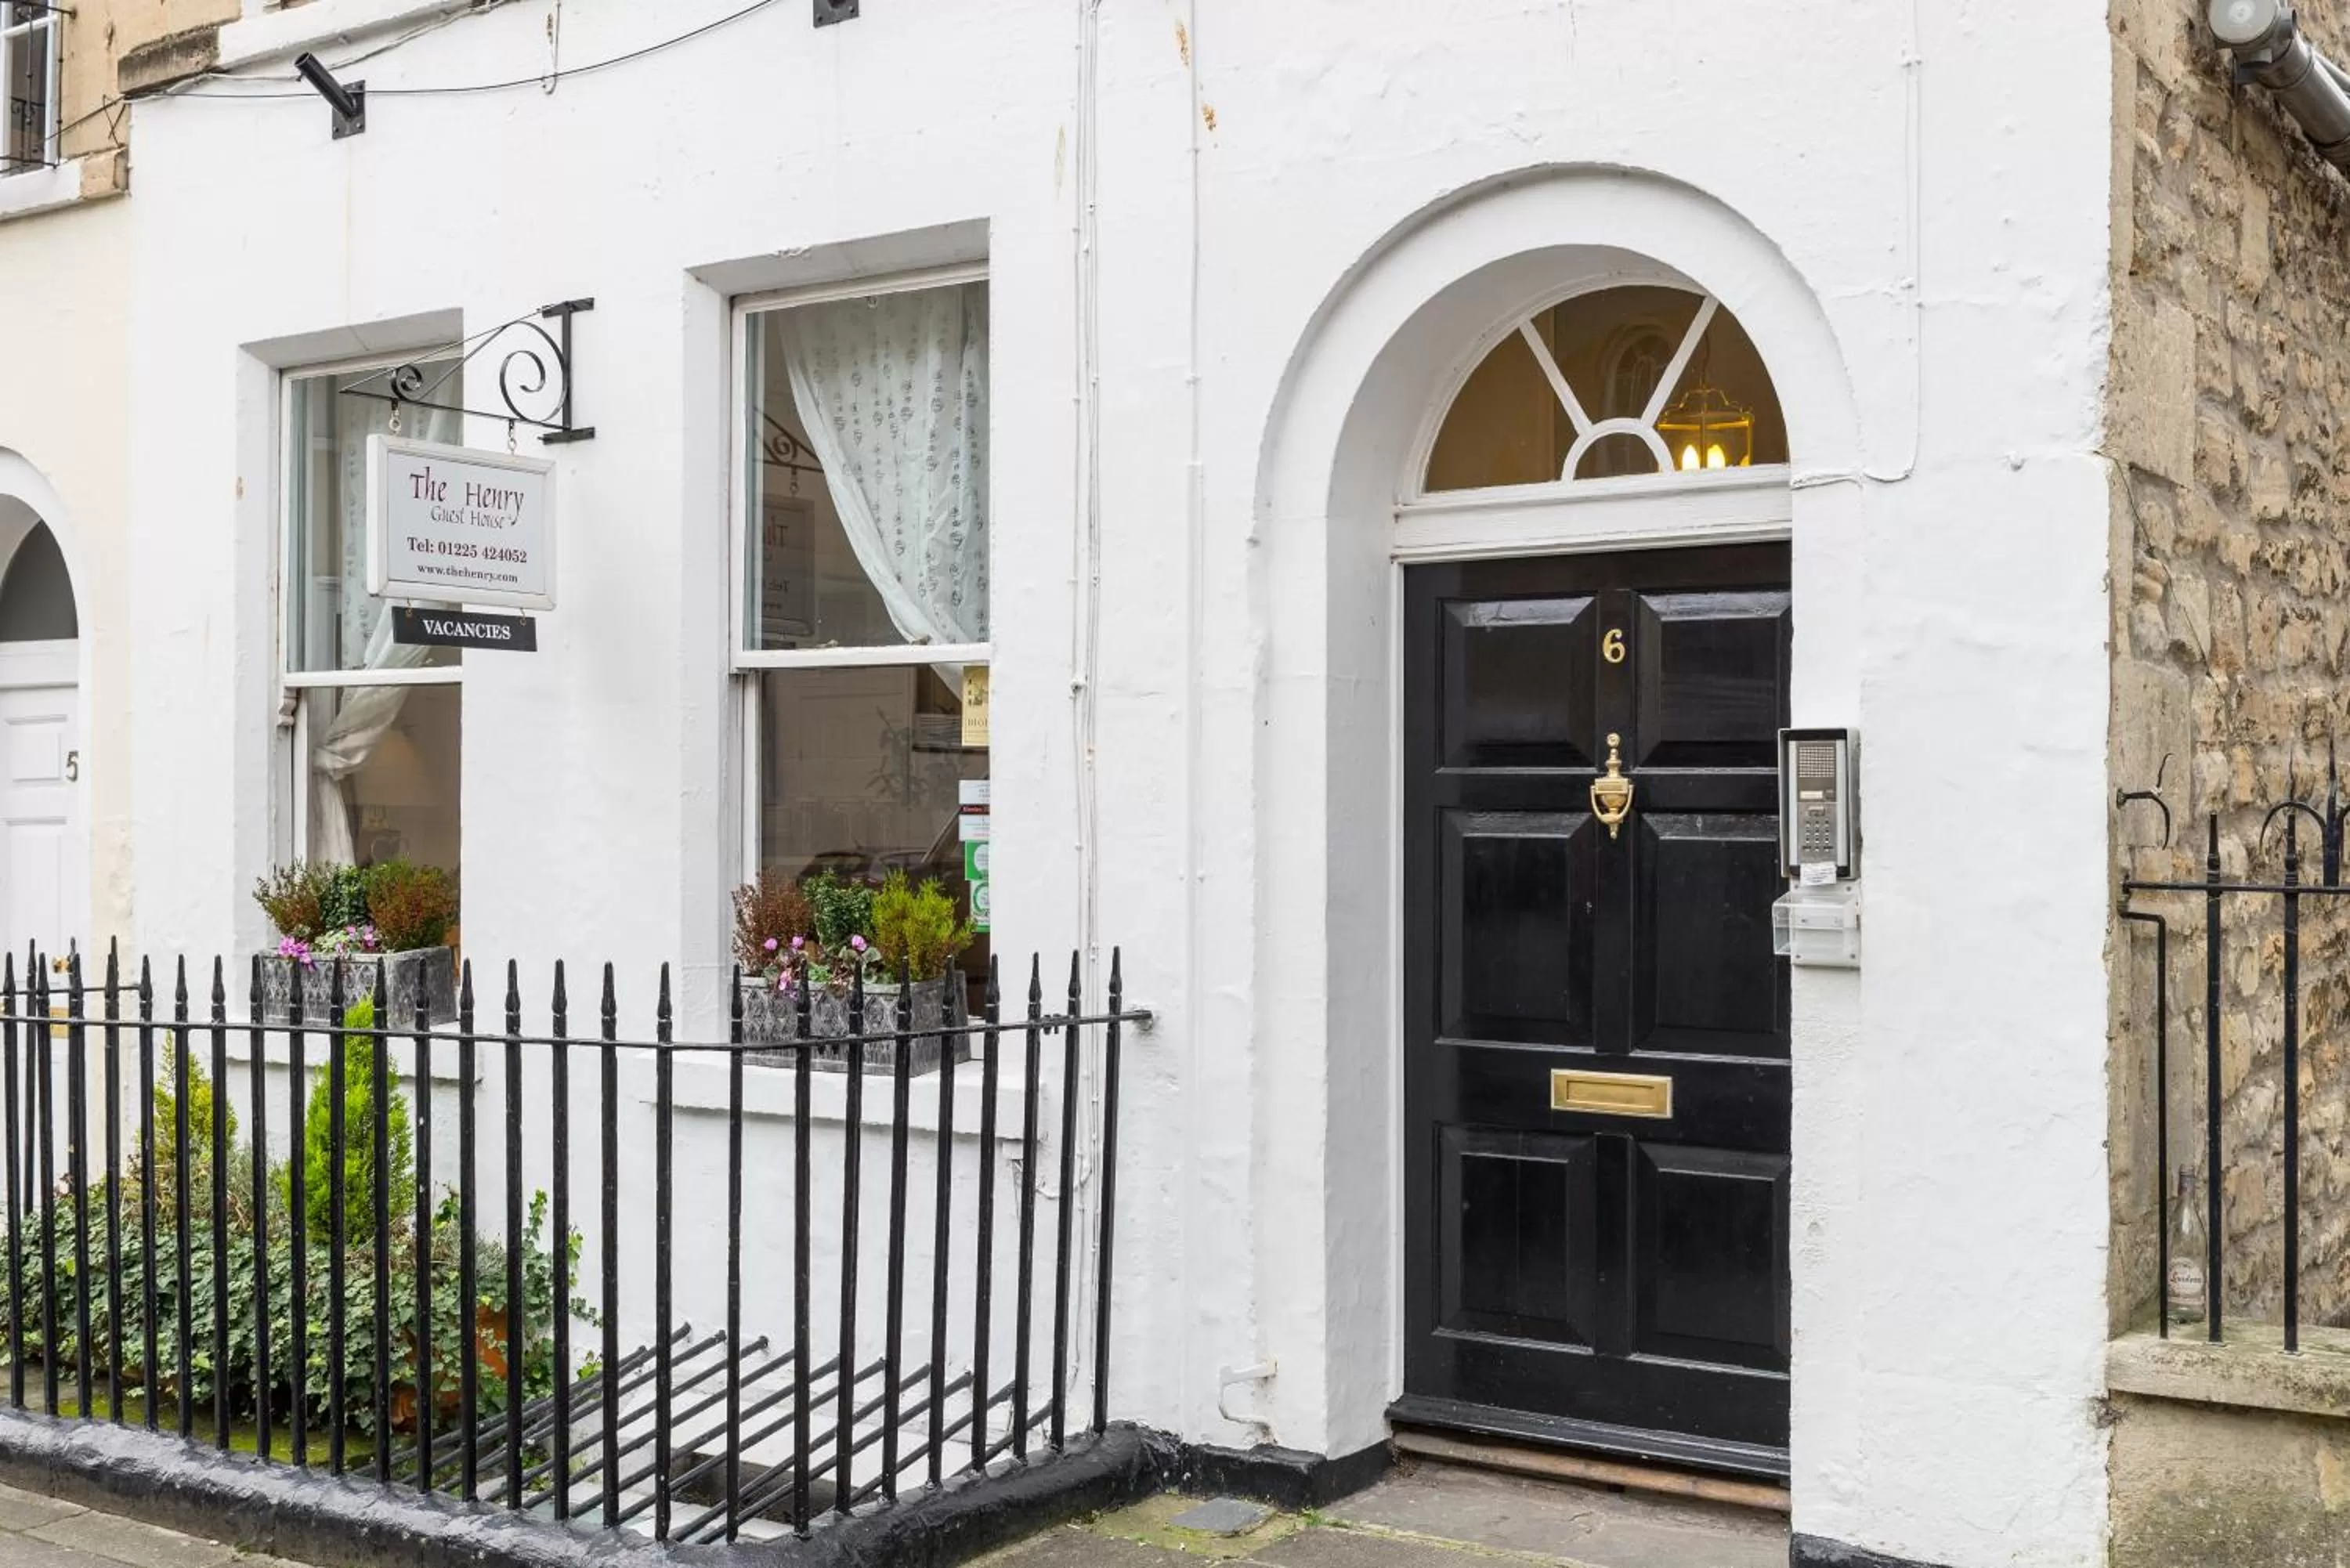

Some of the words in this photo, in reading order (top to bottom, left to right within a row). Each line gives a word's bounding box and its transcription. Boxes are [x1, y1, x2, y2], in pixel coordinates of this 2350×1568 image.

[410, 466, 446, 501] The
[466, 482, 524, 526] Henry
[431, 505, 465, 524] Guest
[471, 511, 504, 529] House
[407, 537, 434, 553] Tel:
[438, 541, 477, 558] 01225
[482, 546, 527, 563] 424052
[418, 565, 518, 583] www.thehenry.com
[423, 620, 511, 640] VACANCIES
[1603, 628, 1626, 663] 6
[65, 750, 79, 783] 5
